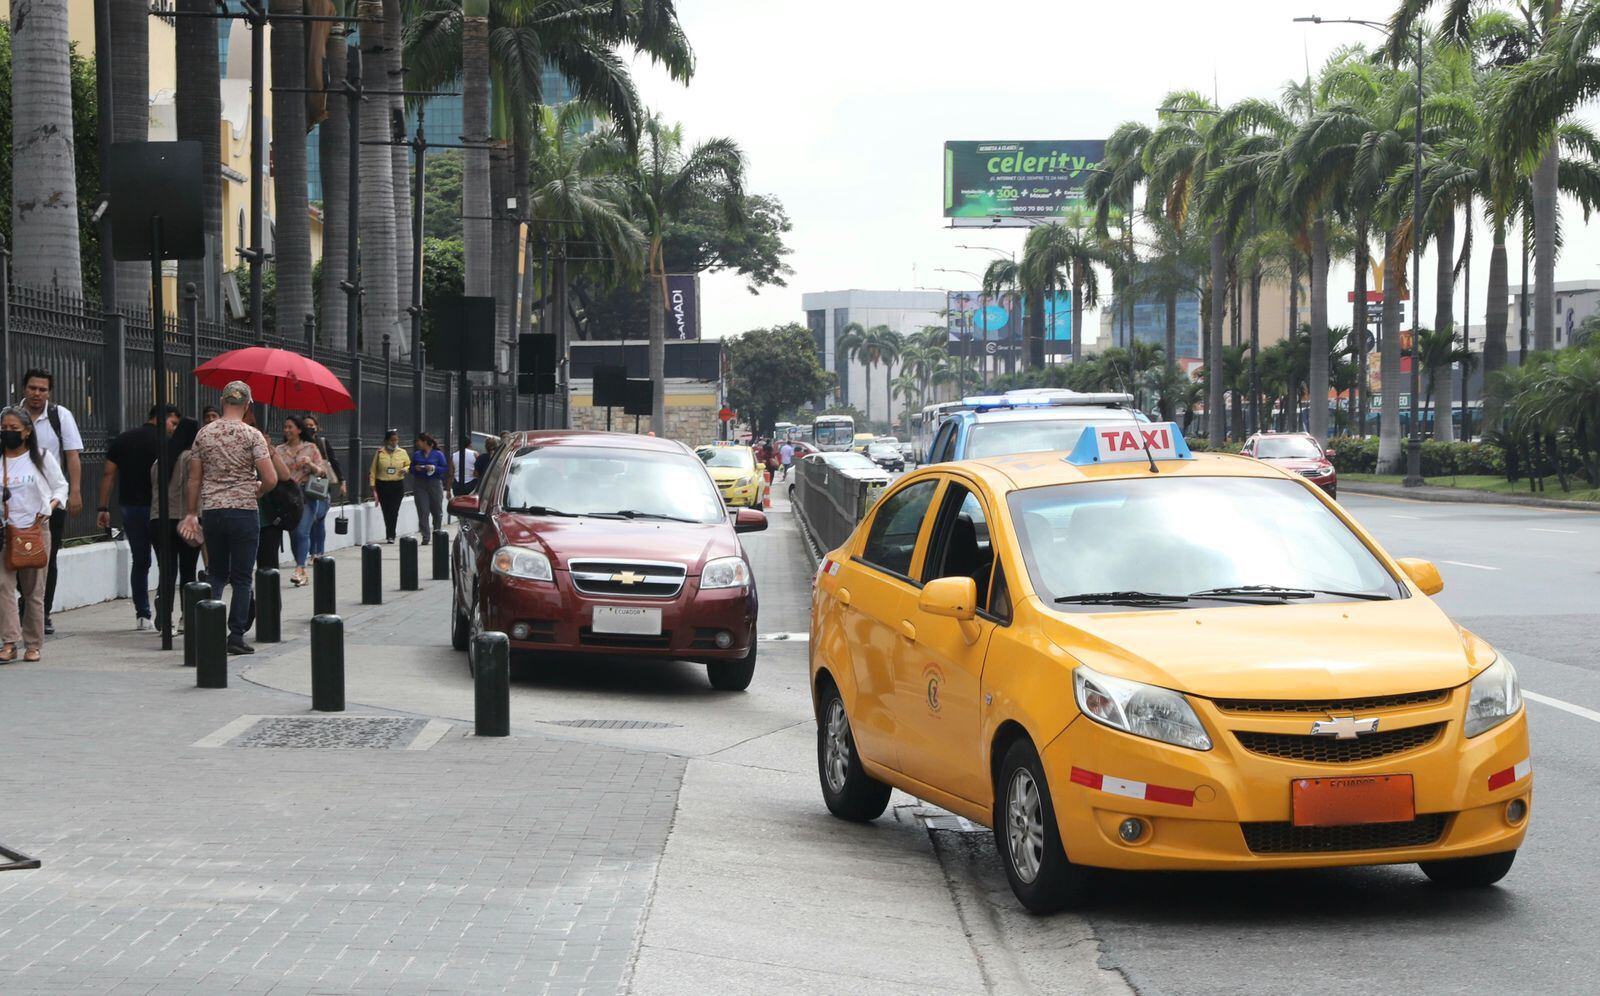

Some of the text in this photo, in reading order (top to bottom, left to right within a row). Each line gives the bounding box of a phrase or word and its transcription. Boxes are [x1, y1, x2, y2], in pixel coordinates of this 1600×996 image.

[987, 150, 1086, 178] celerity
[996, 189, 1018, 198] 300
[672, 290, 686, 340] AMADI
[1101, 429, 1170, 452] TAXI
